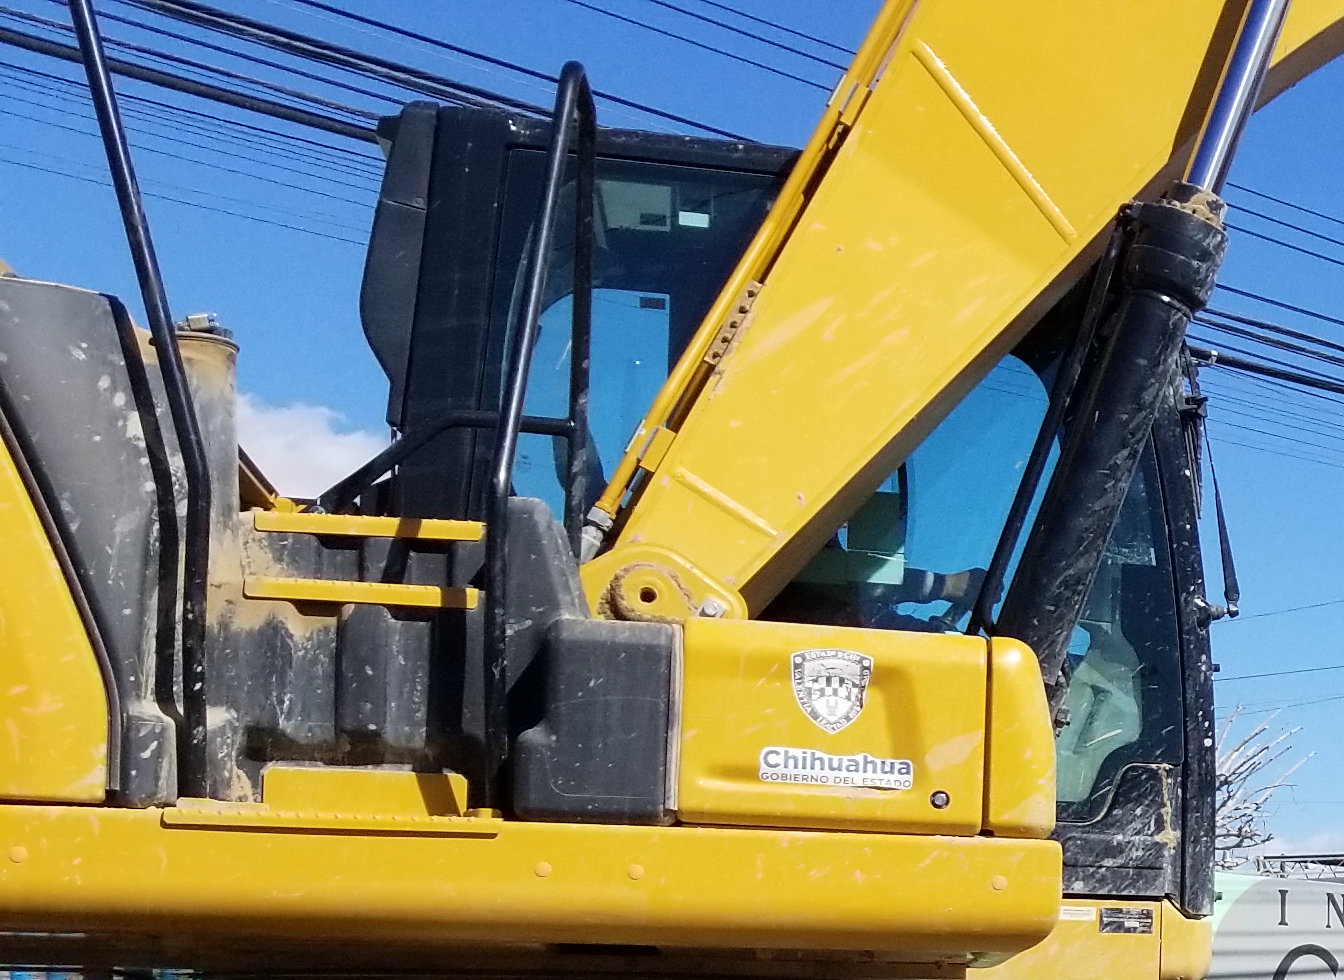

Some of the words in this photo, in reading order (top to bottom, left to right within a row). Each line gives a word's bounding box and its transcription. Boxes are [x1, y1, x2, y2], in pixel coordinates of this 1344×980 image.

[763, 750, 911, 776] Chihuahua
[761, 773, 829, 784] GOBIERNO
[834, 777, 858, 785] DEL
[862, 778, 911, 788] ESTADO
